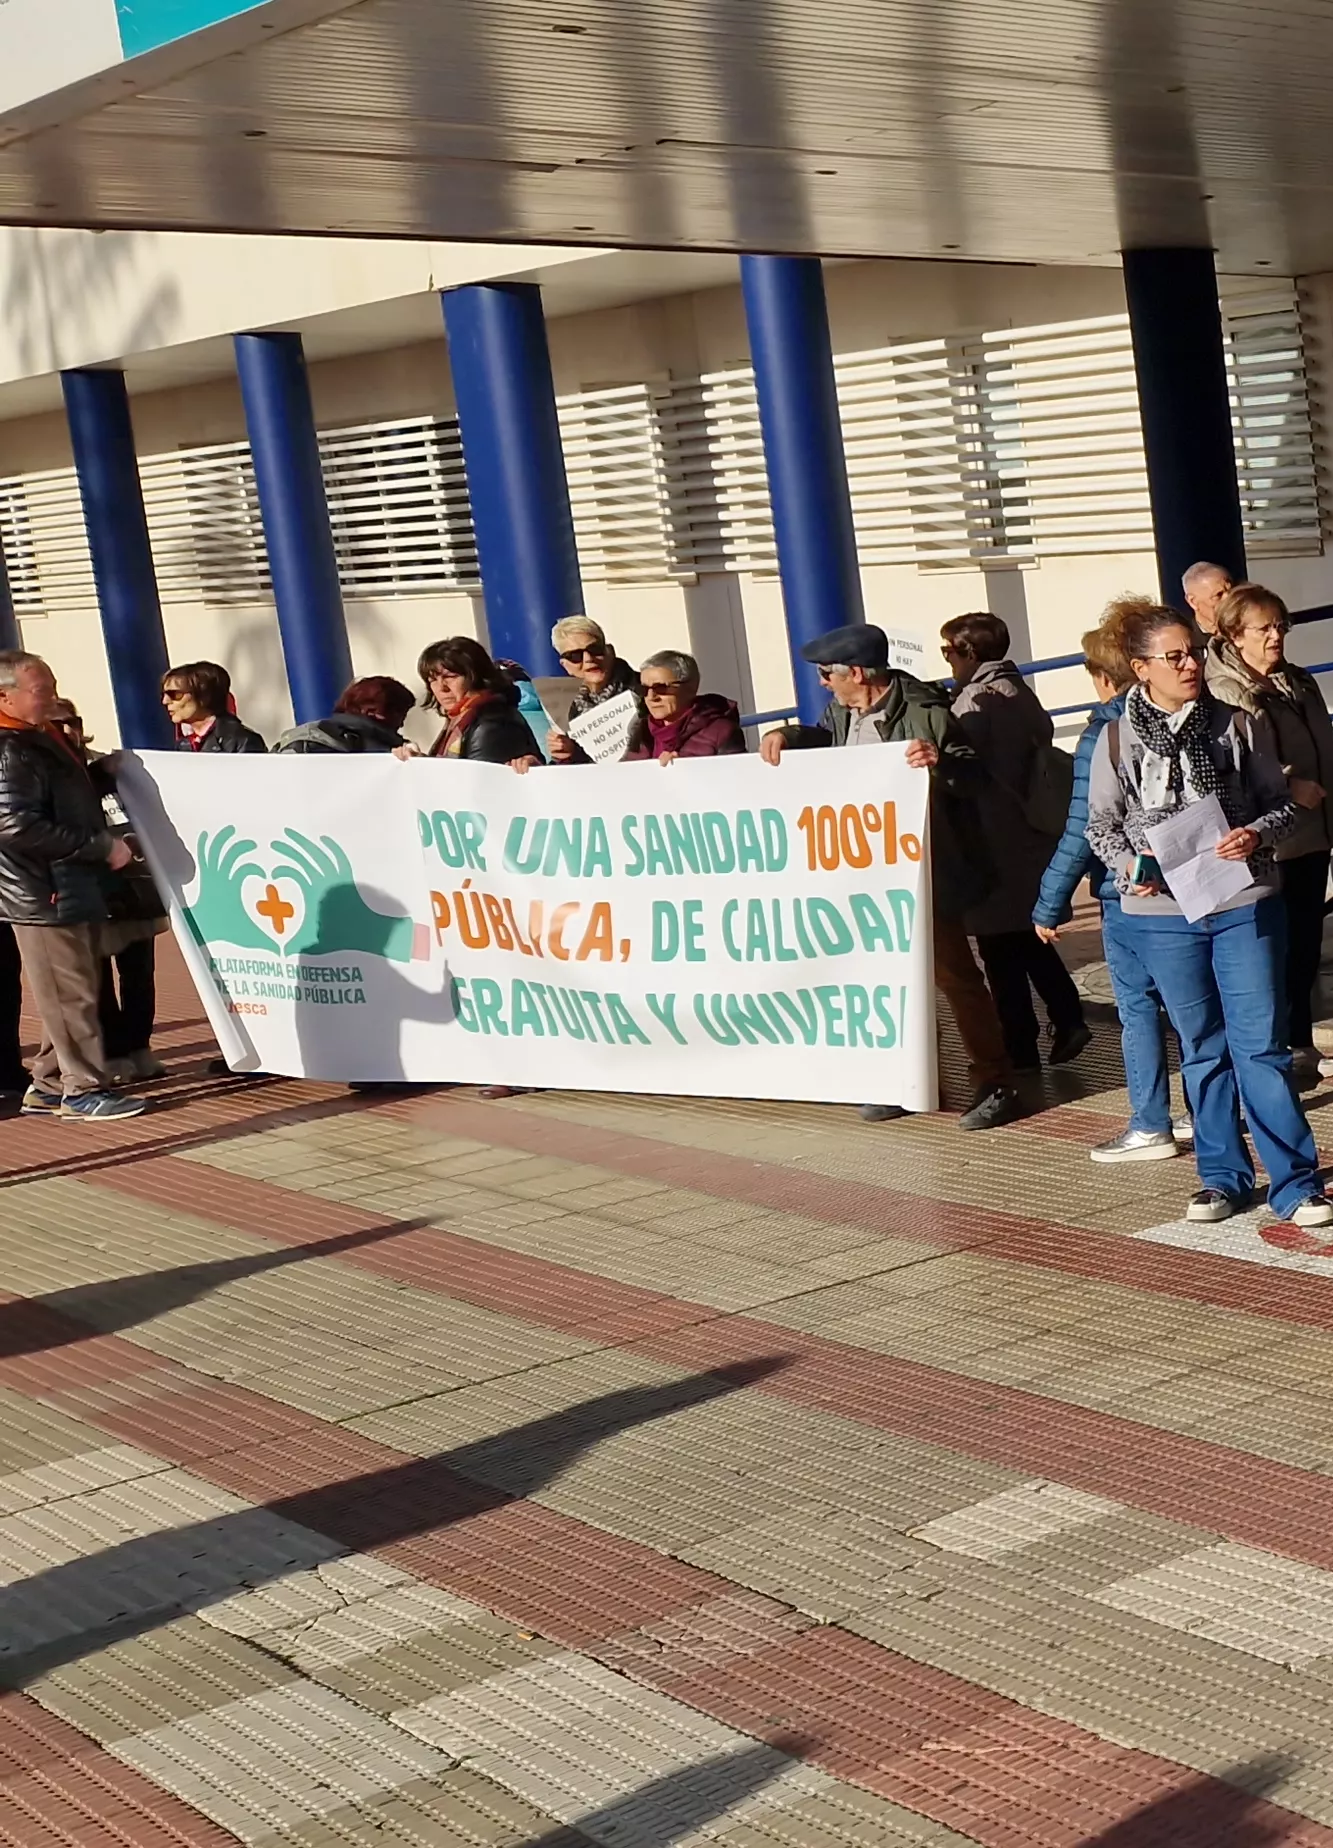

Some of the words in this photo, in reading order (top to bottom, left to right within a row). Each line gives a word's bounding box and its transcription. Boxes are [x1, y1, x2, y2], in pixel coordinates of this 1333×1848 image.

[571, 727, 588, 740] SIN
[587, 701, 635, 731] PERSONAL
[593, 733, 606, 746] NO
[605, 722, 624, 738] HAY
[417, 809, 487, 869] POR
[502, 815, 613, 878] UNA
[624, 808, 789, 877] SANIDAD
[796, 801, 923, 871] 100%
[430, 878, 632, 962] PÚBLICA,
[651, 899, 706, 962] DE
[721, 888, 916, 962] CALIDAD
[210, 957, 284, 979] PLATAFORMA
[286, 964, 300, 980] EN
[301, 965, 364, 983] DEFENSA
[234, 979, 254, 996] LA
[253, 981, 301, 1002] SANIDAD
[304, 984, 367, 1005] PÚBLICA
[451, 976, 653, 1045] GRATUITA
[645, 992, 689, 1046] Y
[692, 984, 906, 1049] UNIVERS
